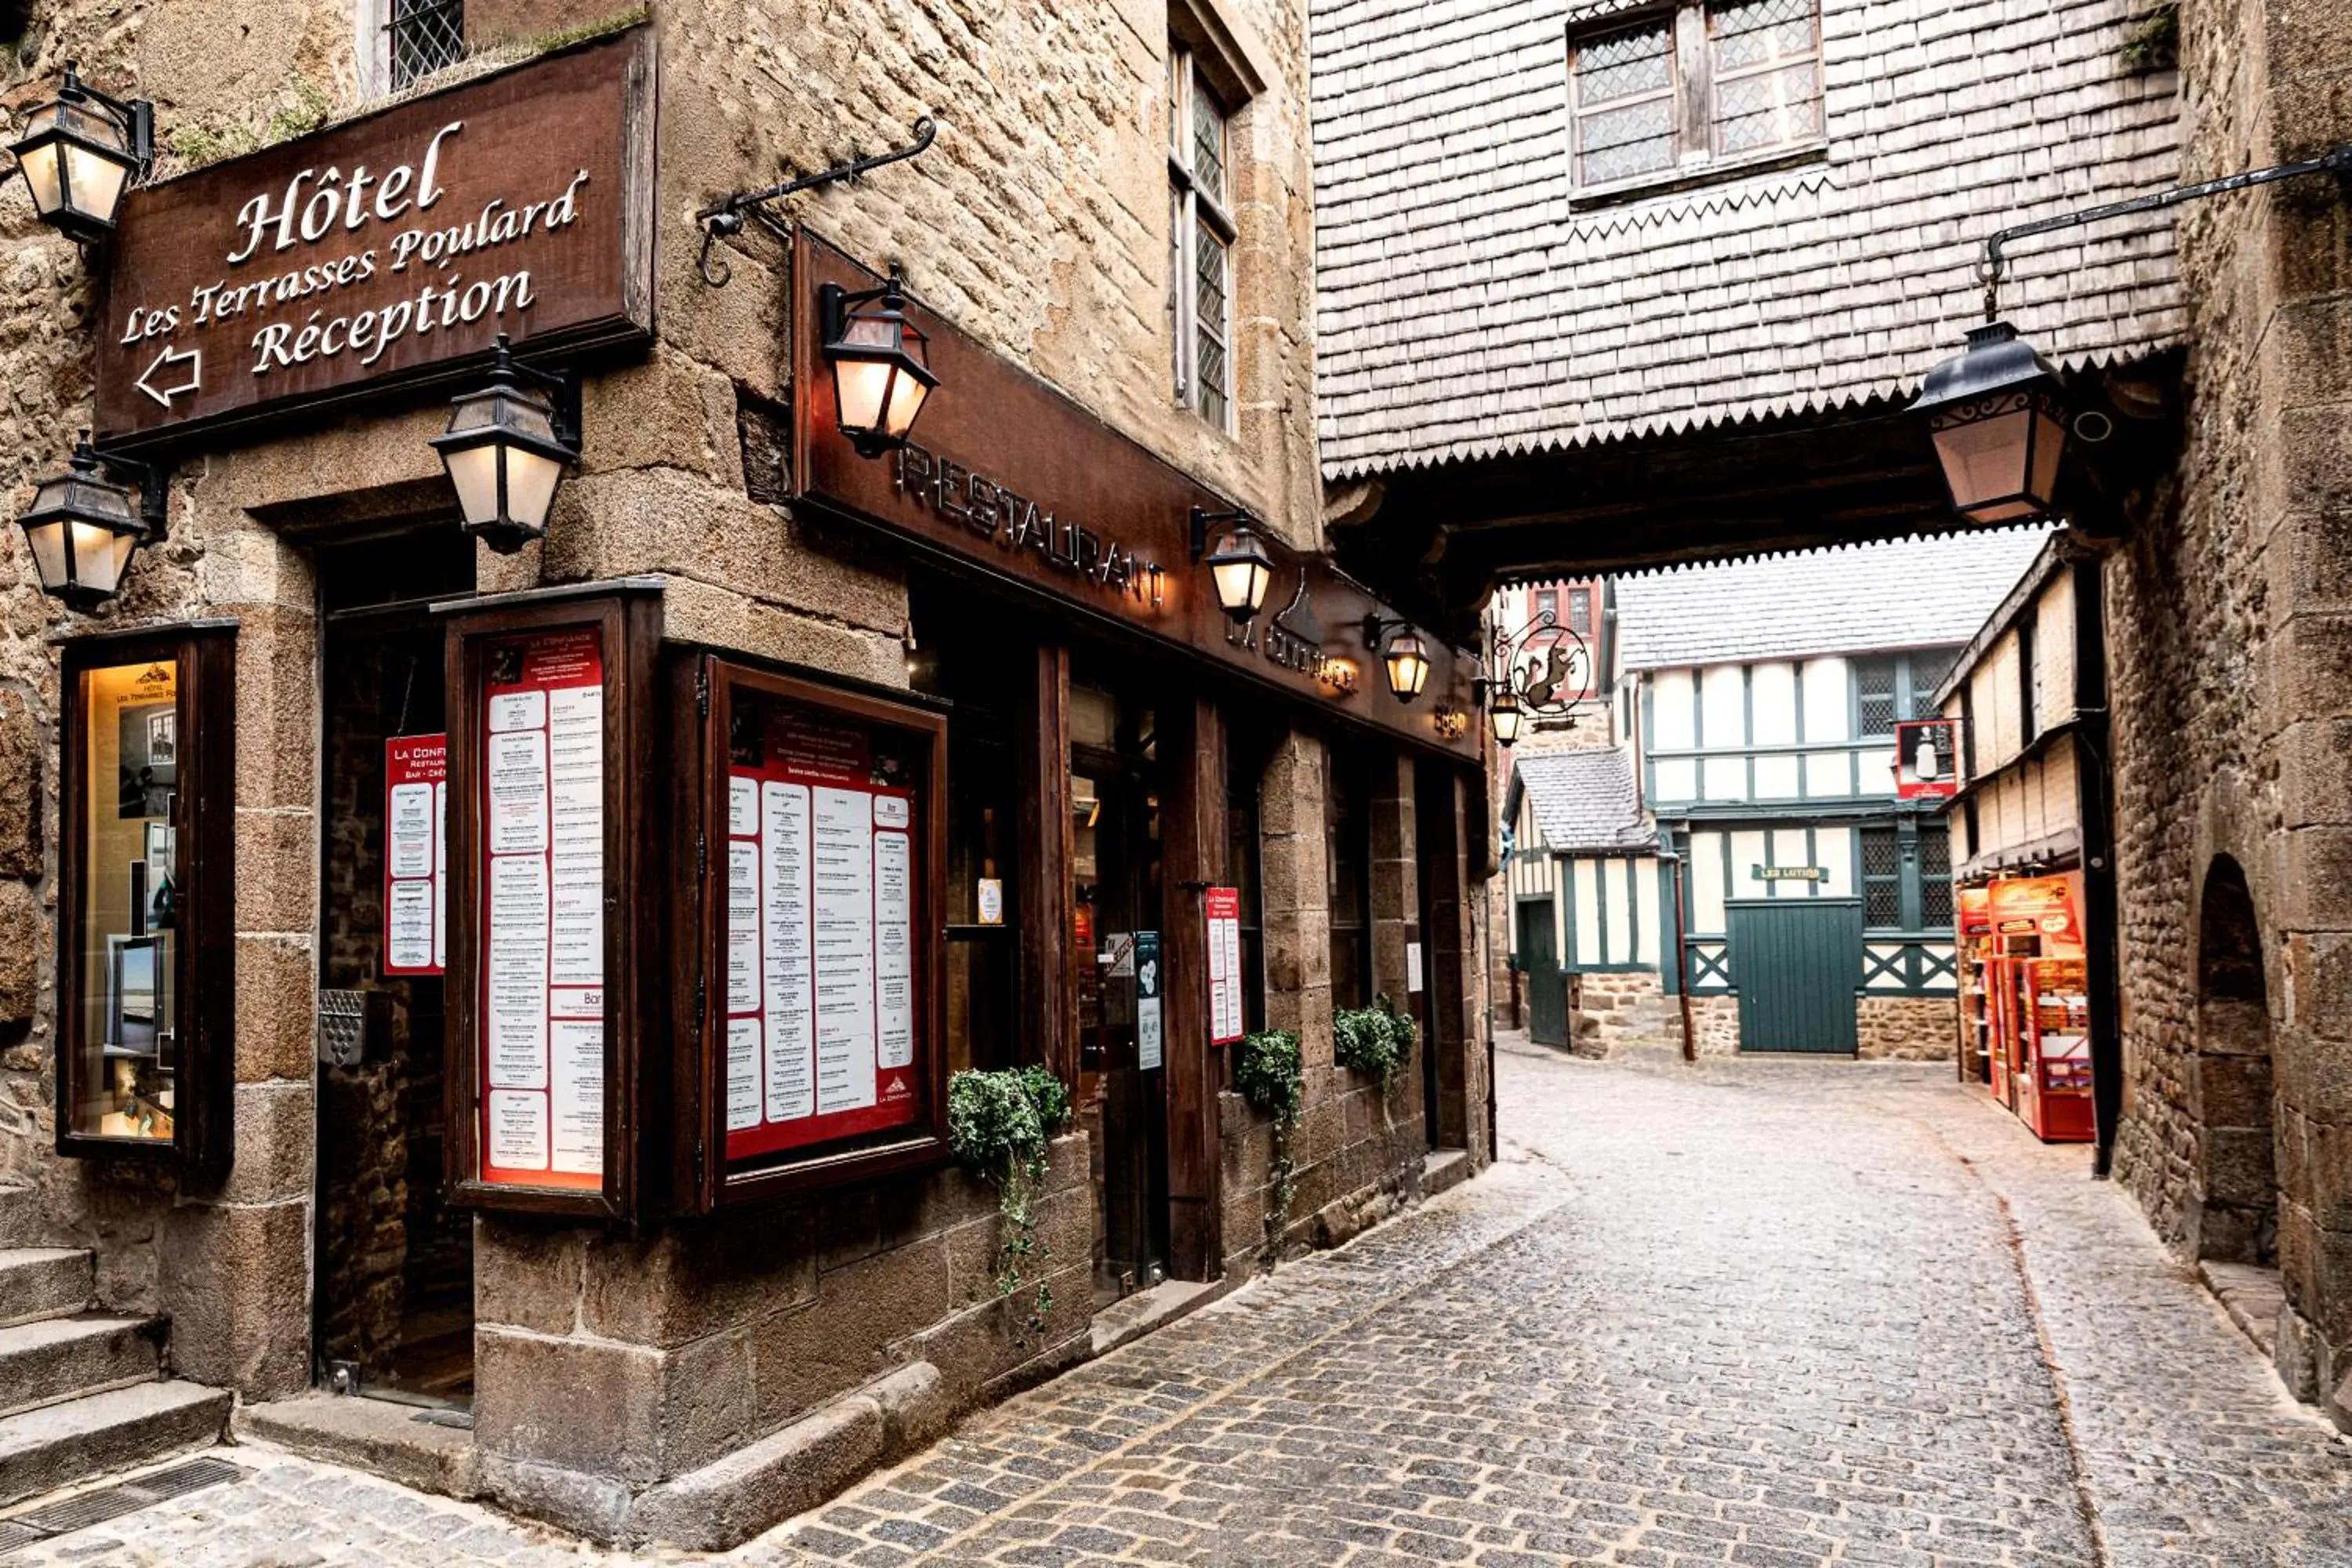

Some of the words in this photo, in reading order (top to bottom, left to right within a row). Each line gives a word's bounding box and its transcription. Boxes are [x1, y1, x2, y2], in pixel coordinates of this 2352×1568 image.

[120, 303, 180, 346] Les
[192, 249, 378, 326] Terrasses
[390, 169, 591, 270] Poulard
[227, 122, 463, 264] Hôtel
[252, 256, 535, 376] Réception
[897, 441, 1166, 607] RESTAURANT
